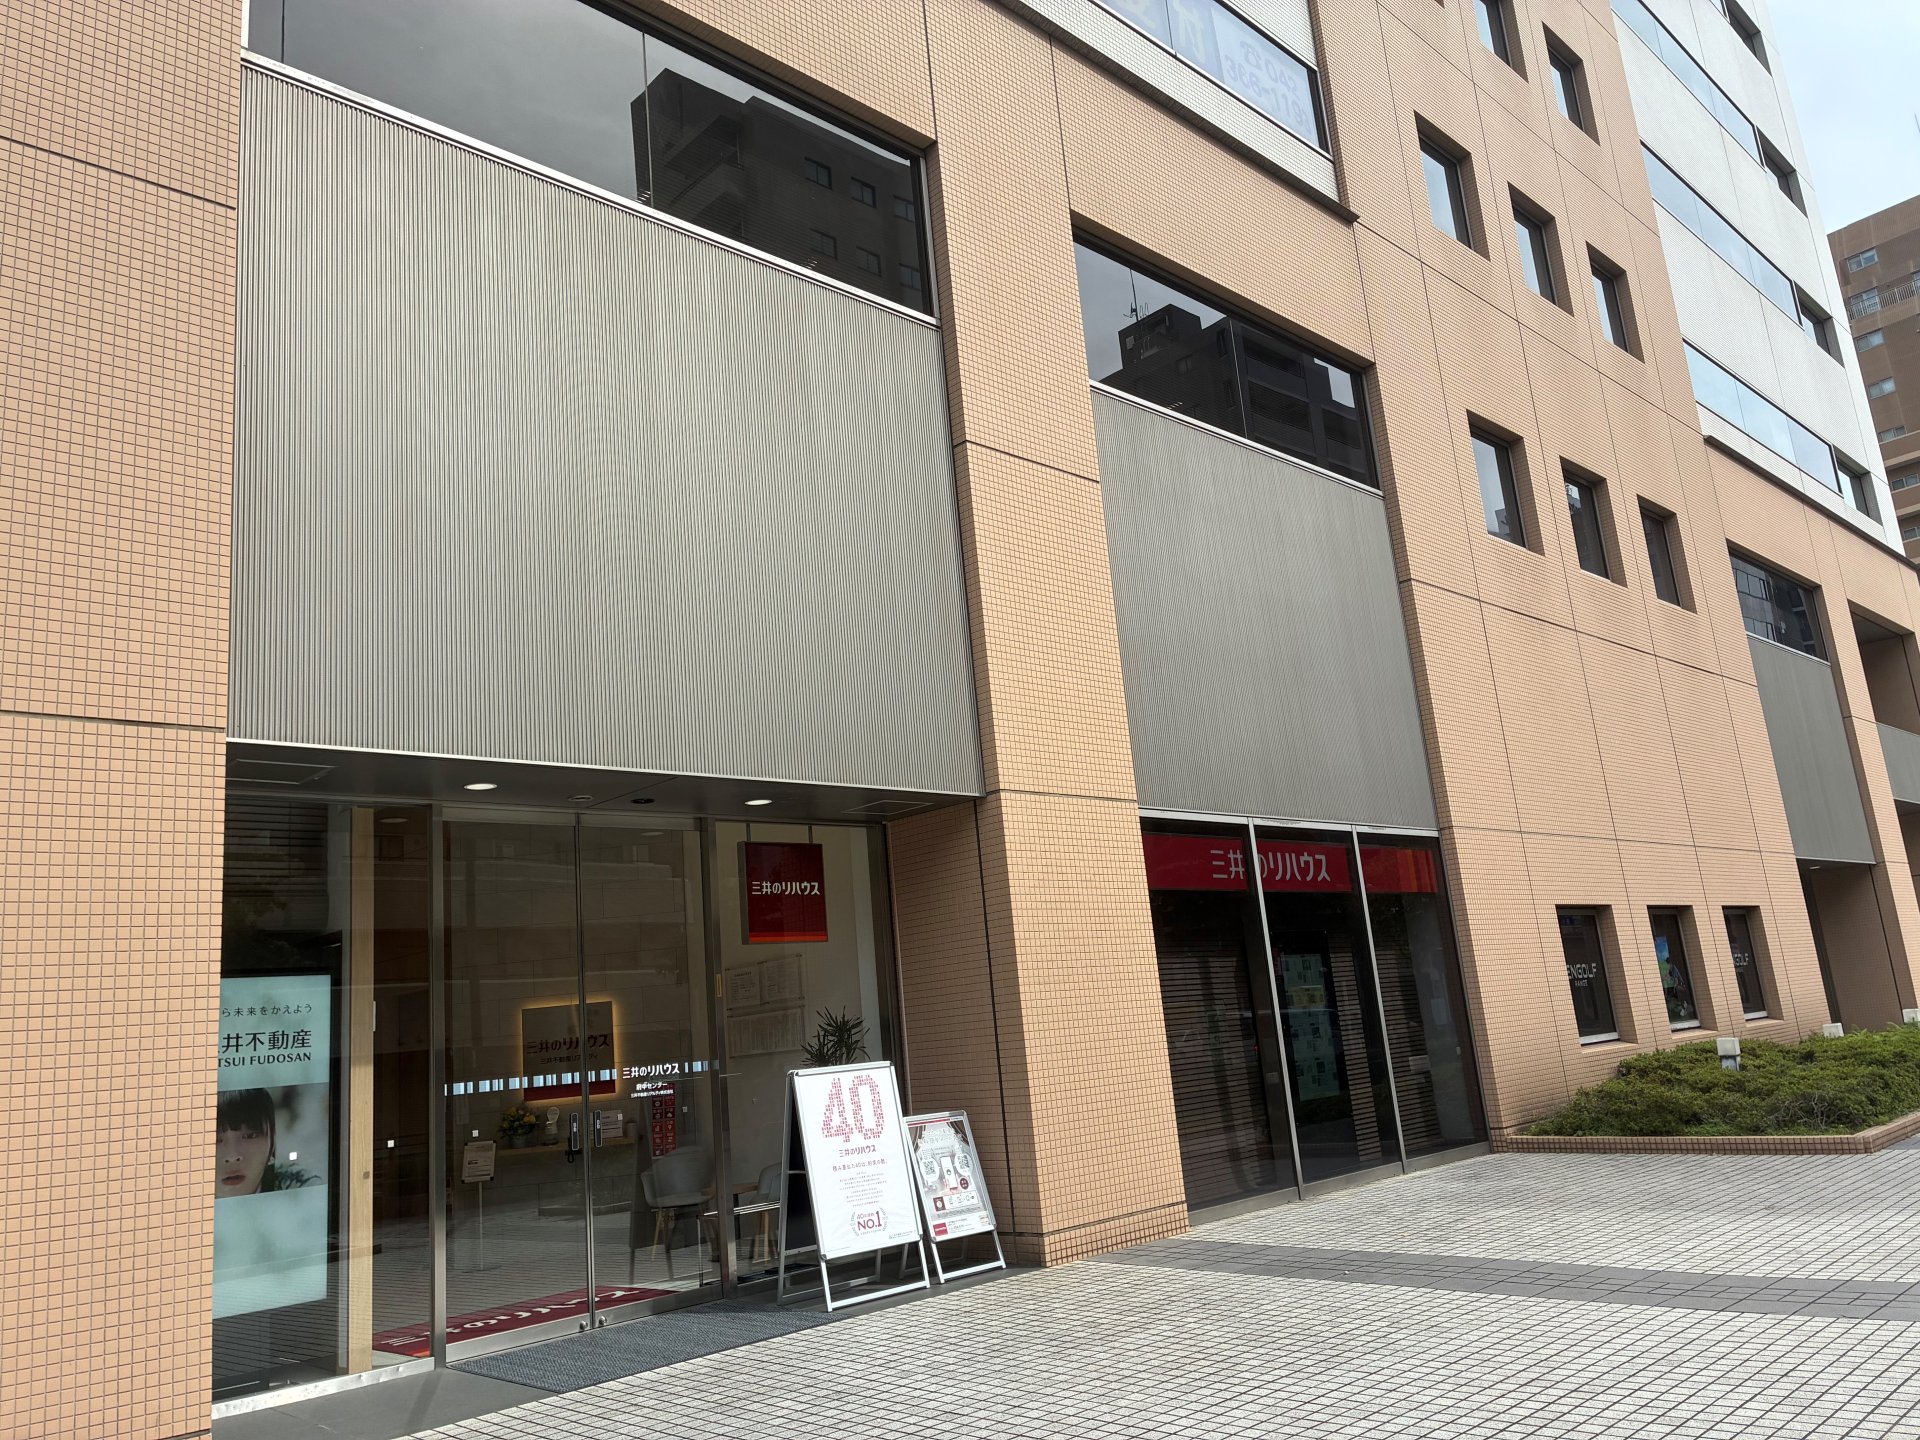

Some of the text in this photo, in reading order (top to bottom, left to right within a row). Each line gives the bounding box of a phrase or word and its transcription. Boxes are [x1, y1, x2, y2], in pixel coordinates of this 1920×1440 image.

[752, 881, 820, 895] 三井のリハウス
[222, 1004, 312, 1018] ら未来をかえよう
[218, 1029, 312, 1054] 井不動産
[249, 1052, 312, 1066] FUDOSAN
[622, 1062, 680, 1079] 三井のリハウス
[822, 1074, 885, 1143] 40
[838, 1144, 876, 1157] 三井のリハウス
